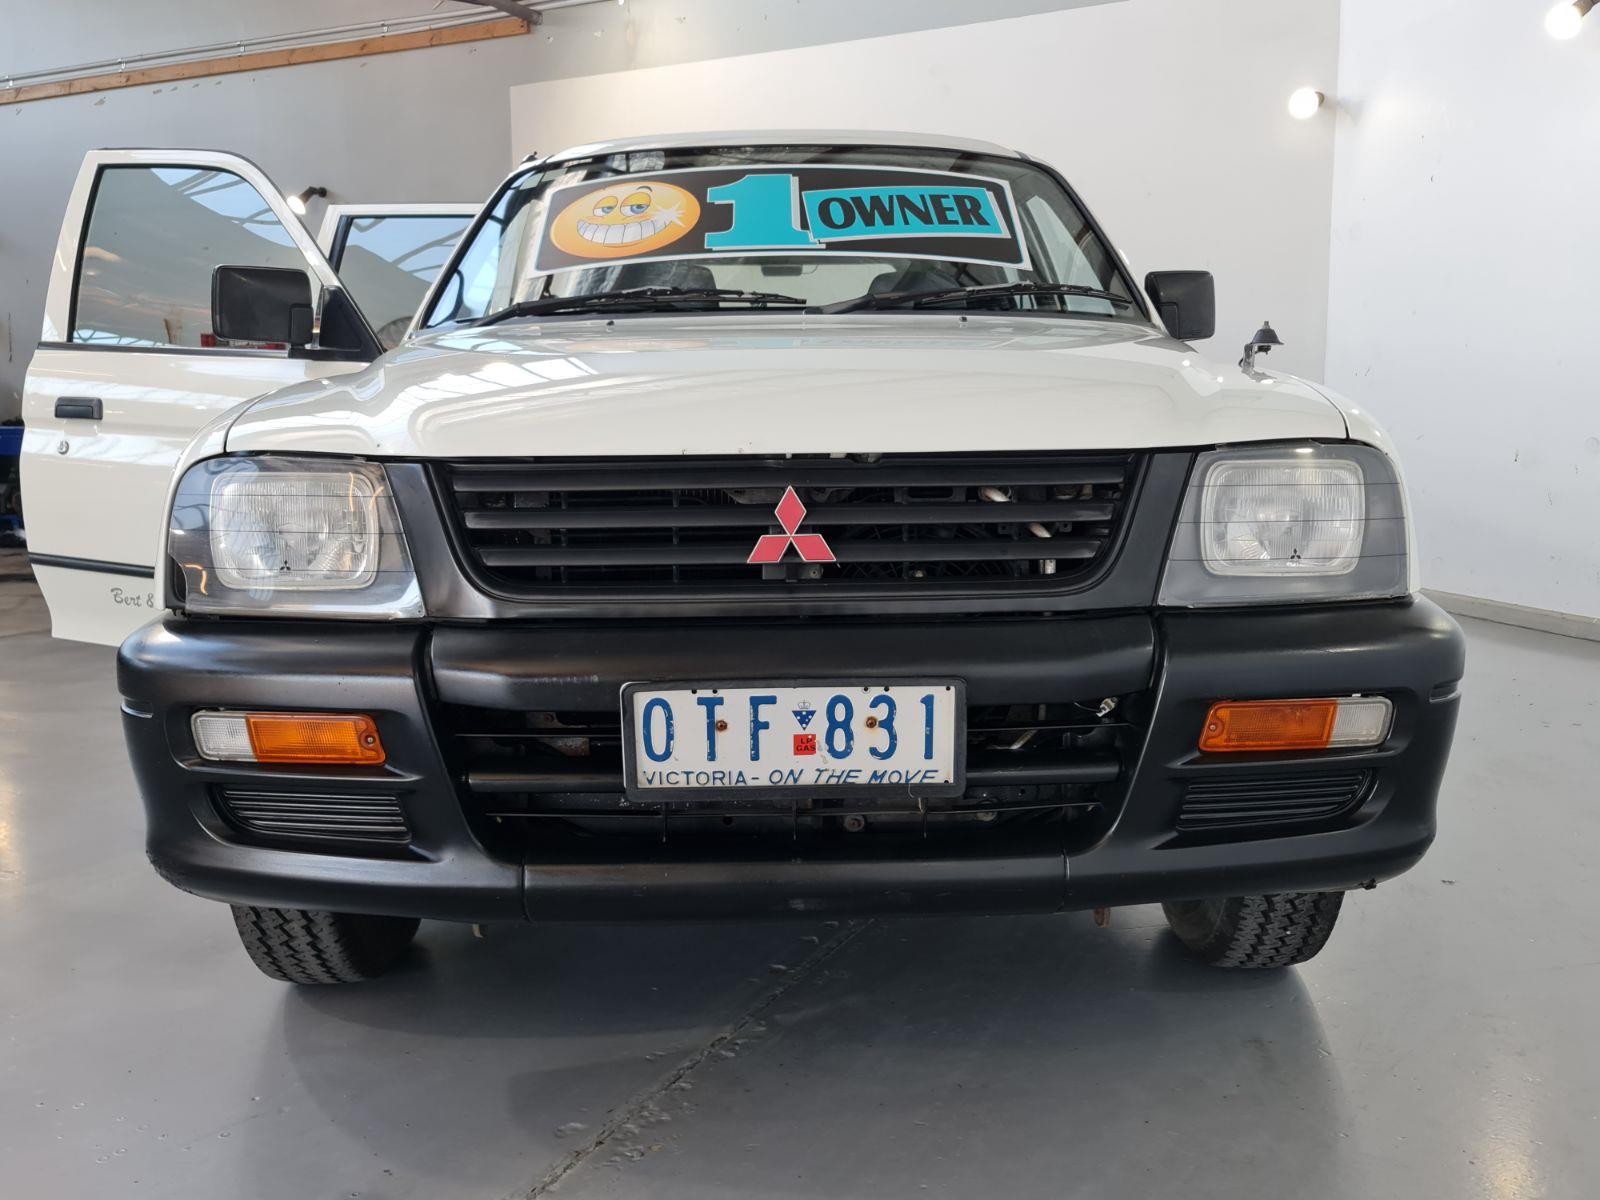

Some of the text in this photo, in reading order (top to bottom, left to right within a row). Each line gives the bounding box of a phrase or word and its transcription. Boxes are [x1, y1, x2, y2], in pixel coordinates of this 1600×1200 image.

[705, 173, 992, 249] 1 OWNER
[110, 587, 142, 607] Bert
[642, 693, 935, 762] OTF 831
[796, 744, 816, 752] GAS
[768, 768, 804, 785] ON
[814, 768, 862, 784] THE
[867, 768, 939, 784] MOVE
